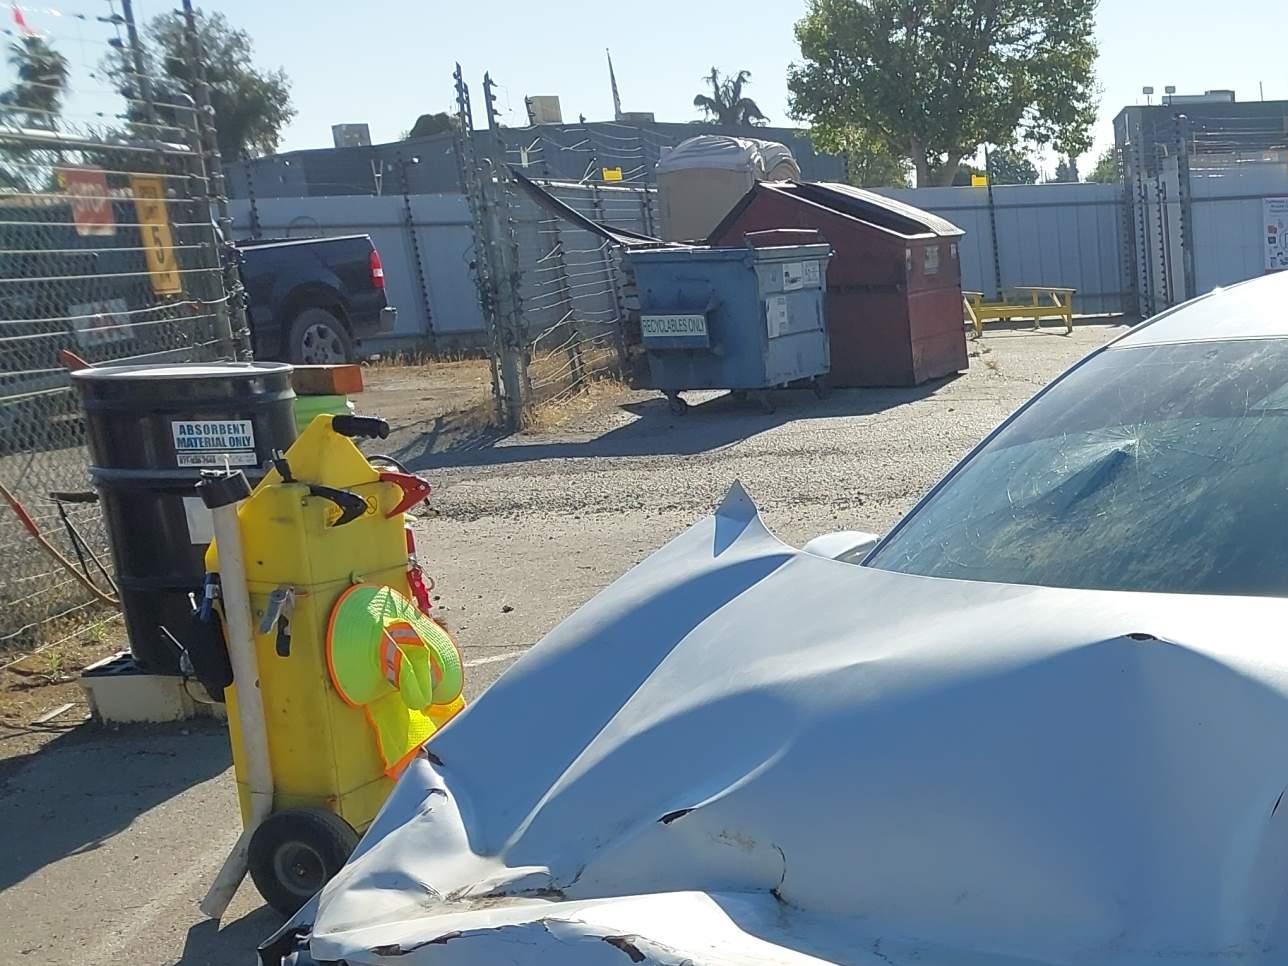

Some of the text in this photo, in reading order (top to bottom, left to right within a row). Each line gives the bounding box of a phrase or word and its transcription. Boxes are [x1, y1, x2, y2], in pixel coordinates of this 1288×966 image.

[642, 319, 687, 333] RECYCLABLES
[179, 423, 246, 436] ABSORBENT
[176, 436, 251, 448] MATERIAL ONLY
